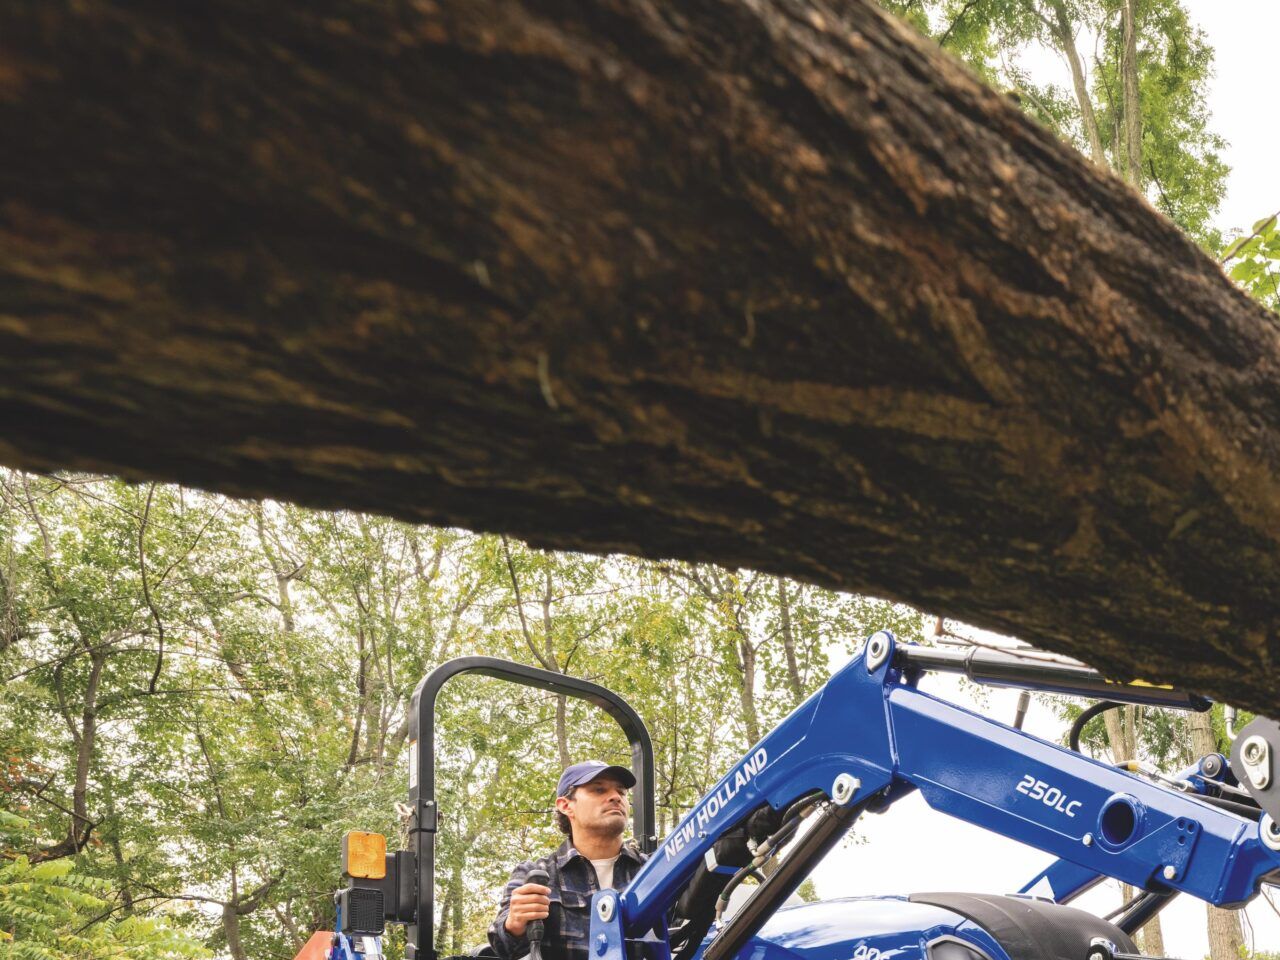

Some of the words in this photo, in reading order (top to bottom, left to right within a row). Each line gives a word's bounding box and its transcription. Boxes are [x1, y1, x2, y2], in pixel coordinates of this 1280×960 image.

[664, 818, 696, 862] NEW
[696, 747, 768, 830] HOLLAND
[1015, 774, 1083, 818] 250LC
